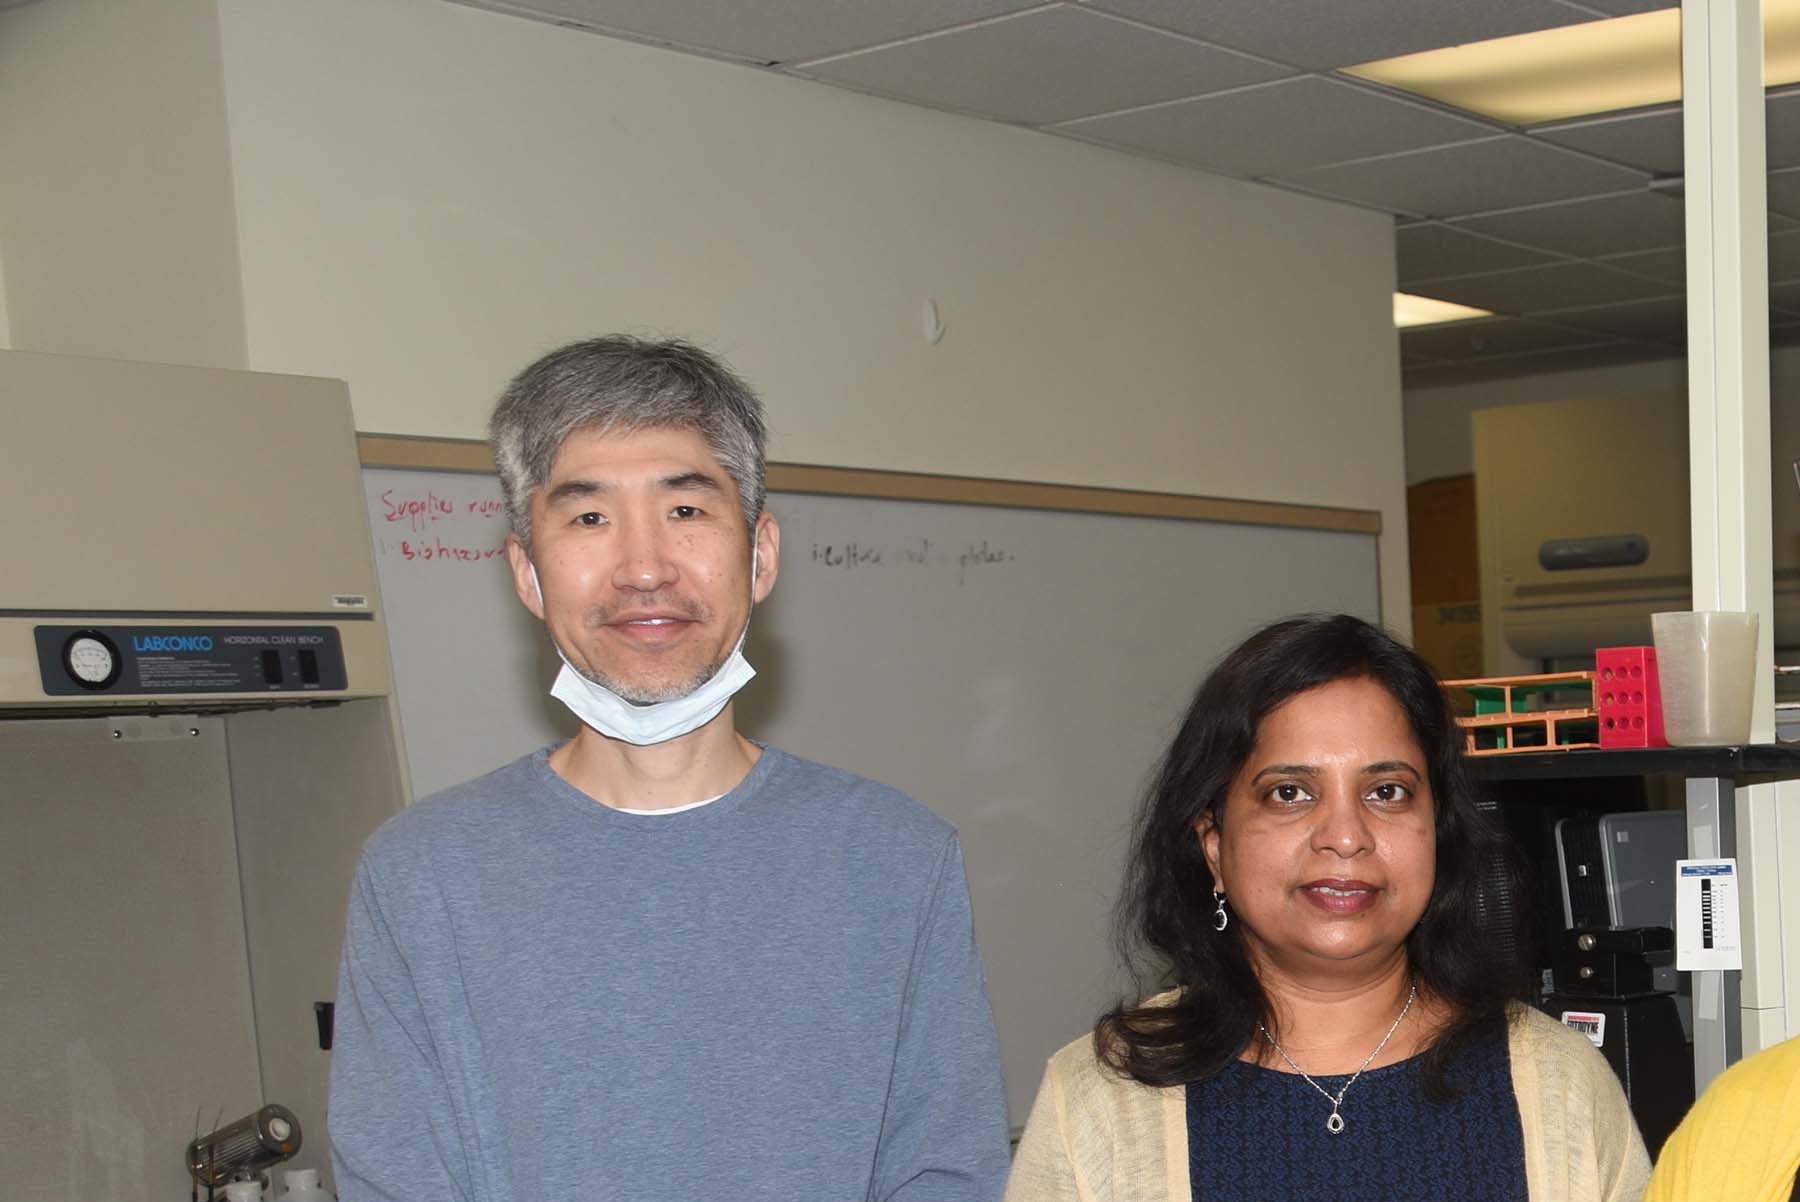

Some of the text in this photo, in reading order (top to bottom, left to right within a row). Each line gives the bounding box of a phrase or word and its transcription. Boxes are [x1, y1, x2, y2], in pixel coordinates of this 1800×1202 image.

[382, 489, 504, 533] Supplies runn
[133, 634, 214, 651] LABCONCO
[223, 635, 324, 645] HORIZONTAL CLEAN BENCH
